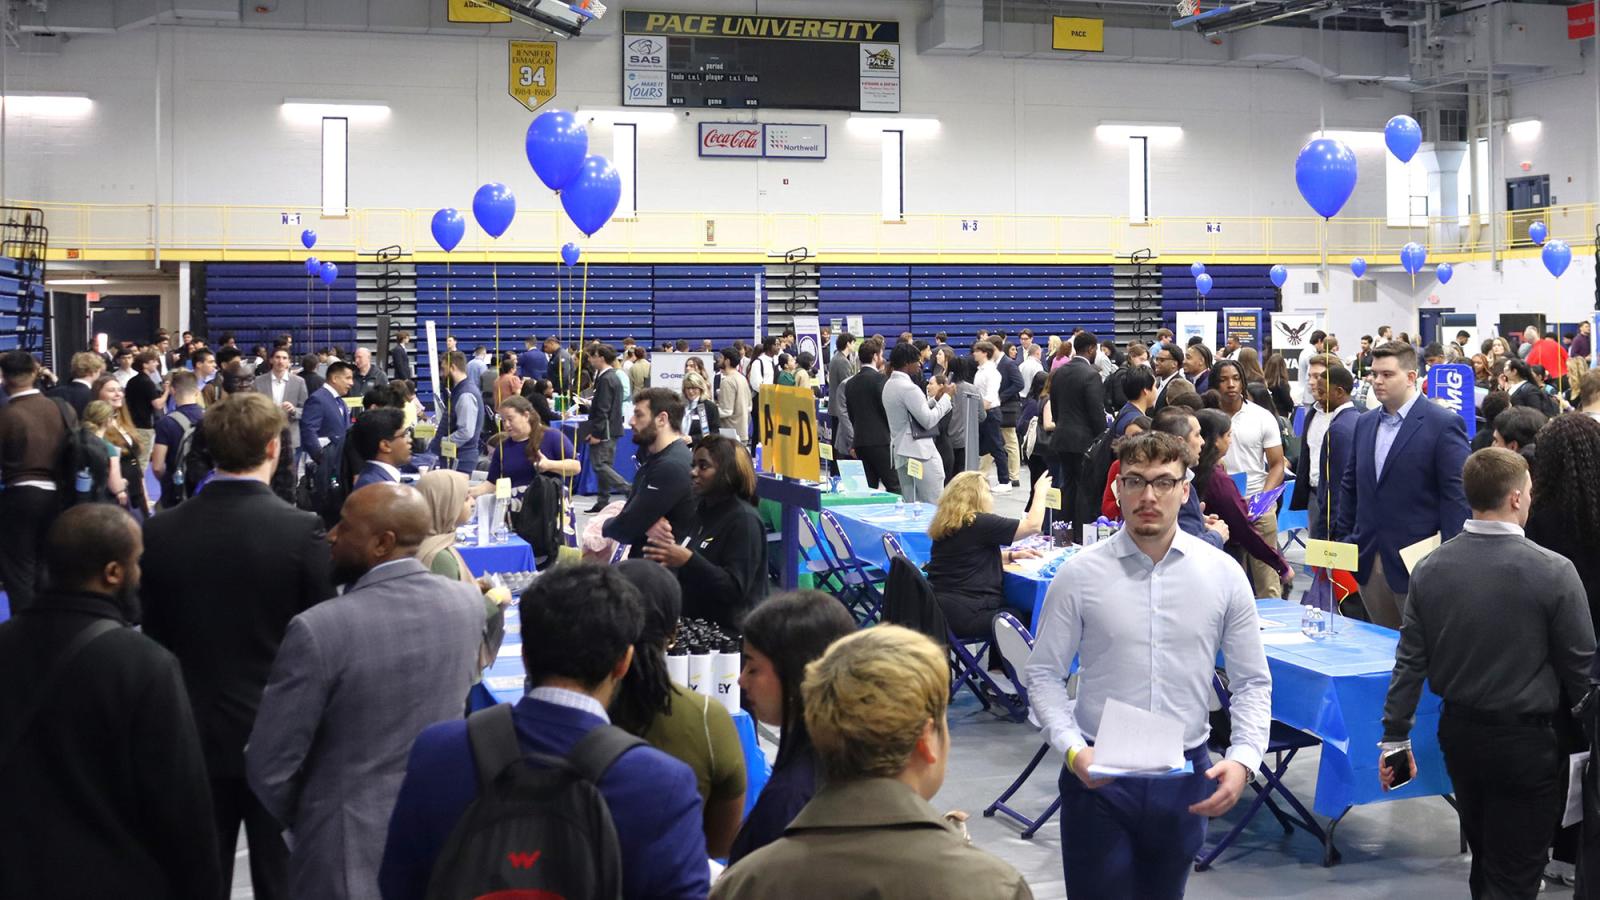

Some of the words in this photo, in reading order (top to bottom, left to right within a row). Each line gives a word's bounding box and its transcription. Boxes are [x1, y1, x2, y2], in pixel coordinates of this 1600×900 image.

[645, 13, 717, 33] PACE
[721, 17, 881, 40] UNIVERSITY
[516, 49, 551, 57] JENNIFER
[629, 55, 662, 64] SAS
[866, 57, 896, 66] PACE
[706, 62, 724, 70] period
[519, 65, 546, 87] 34
[705, 73, 724, 81] player
[627, 84, 664, 100] YOURS
[704, 129, 760, 149] Coca-Cola
[784, 144, 819, 152] Northwell
[282, 215, 300, 224] N-1
[962, 222, 978, 231] N-3
[1207, 224, 1221, 232] N-4
[1447, 371, 1463, 413] MG
[718, 683, 731, 694] EY
